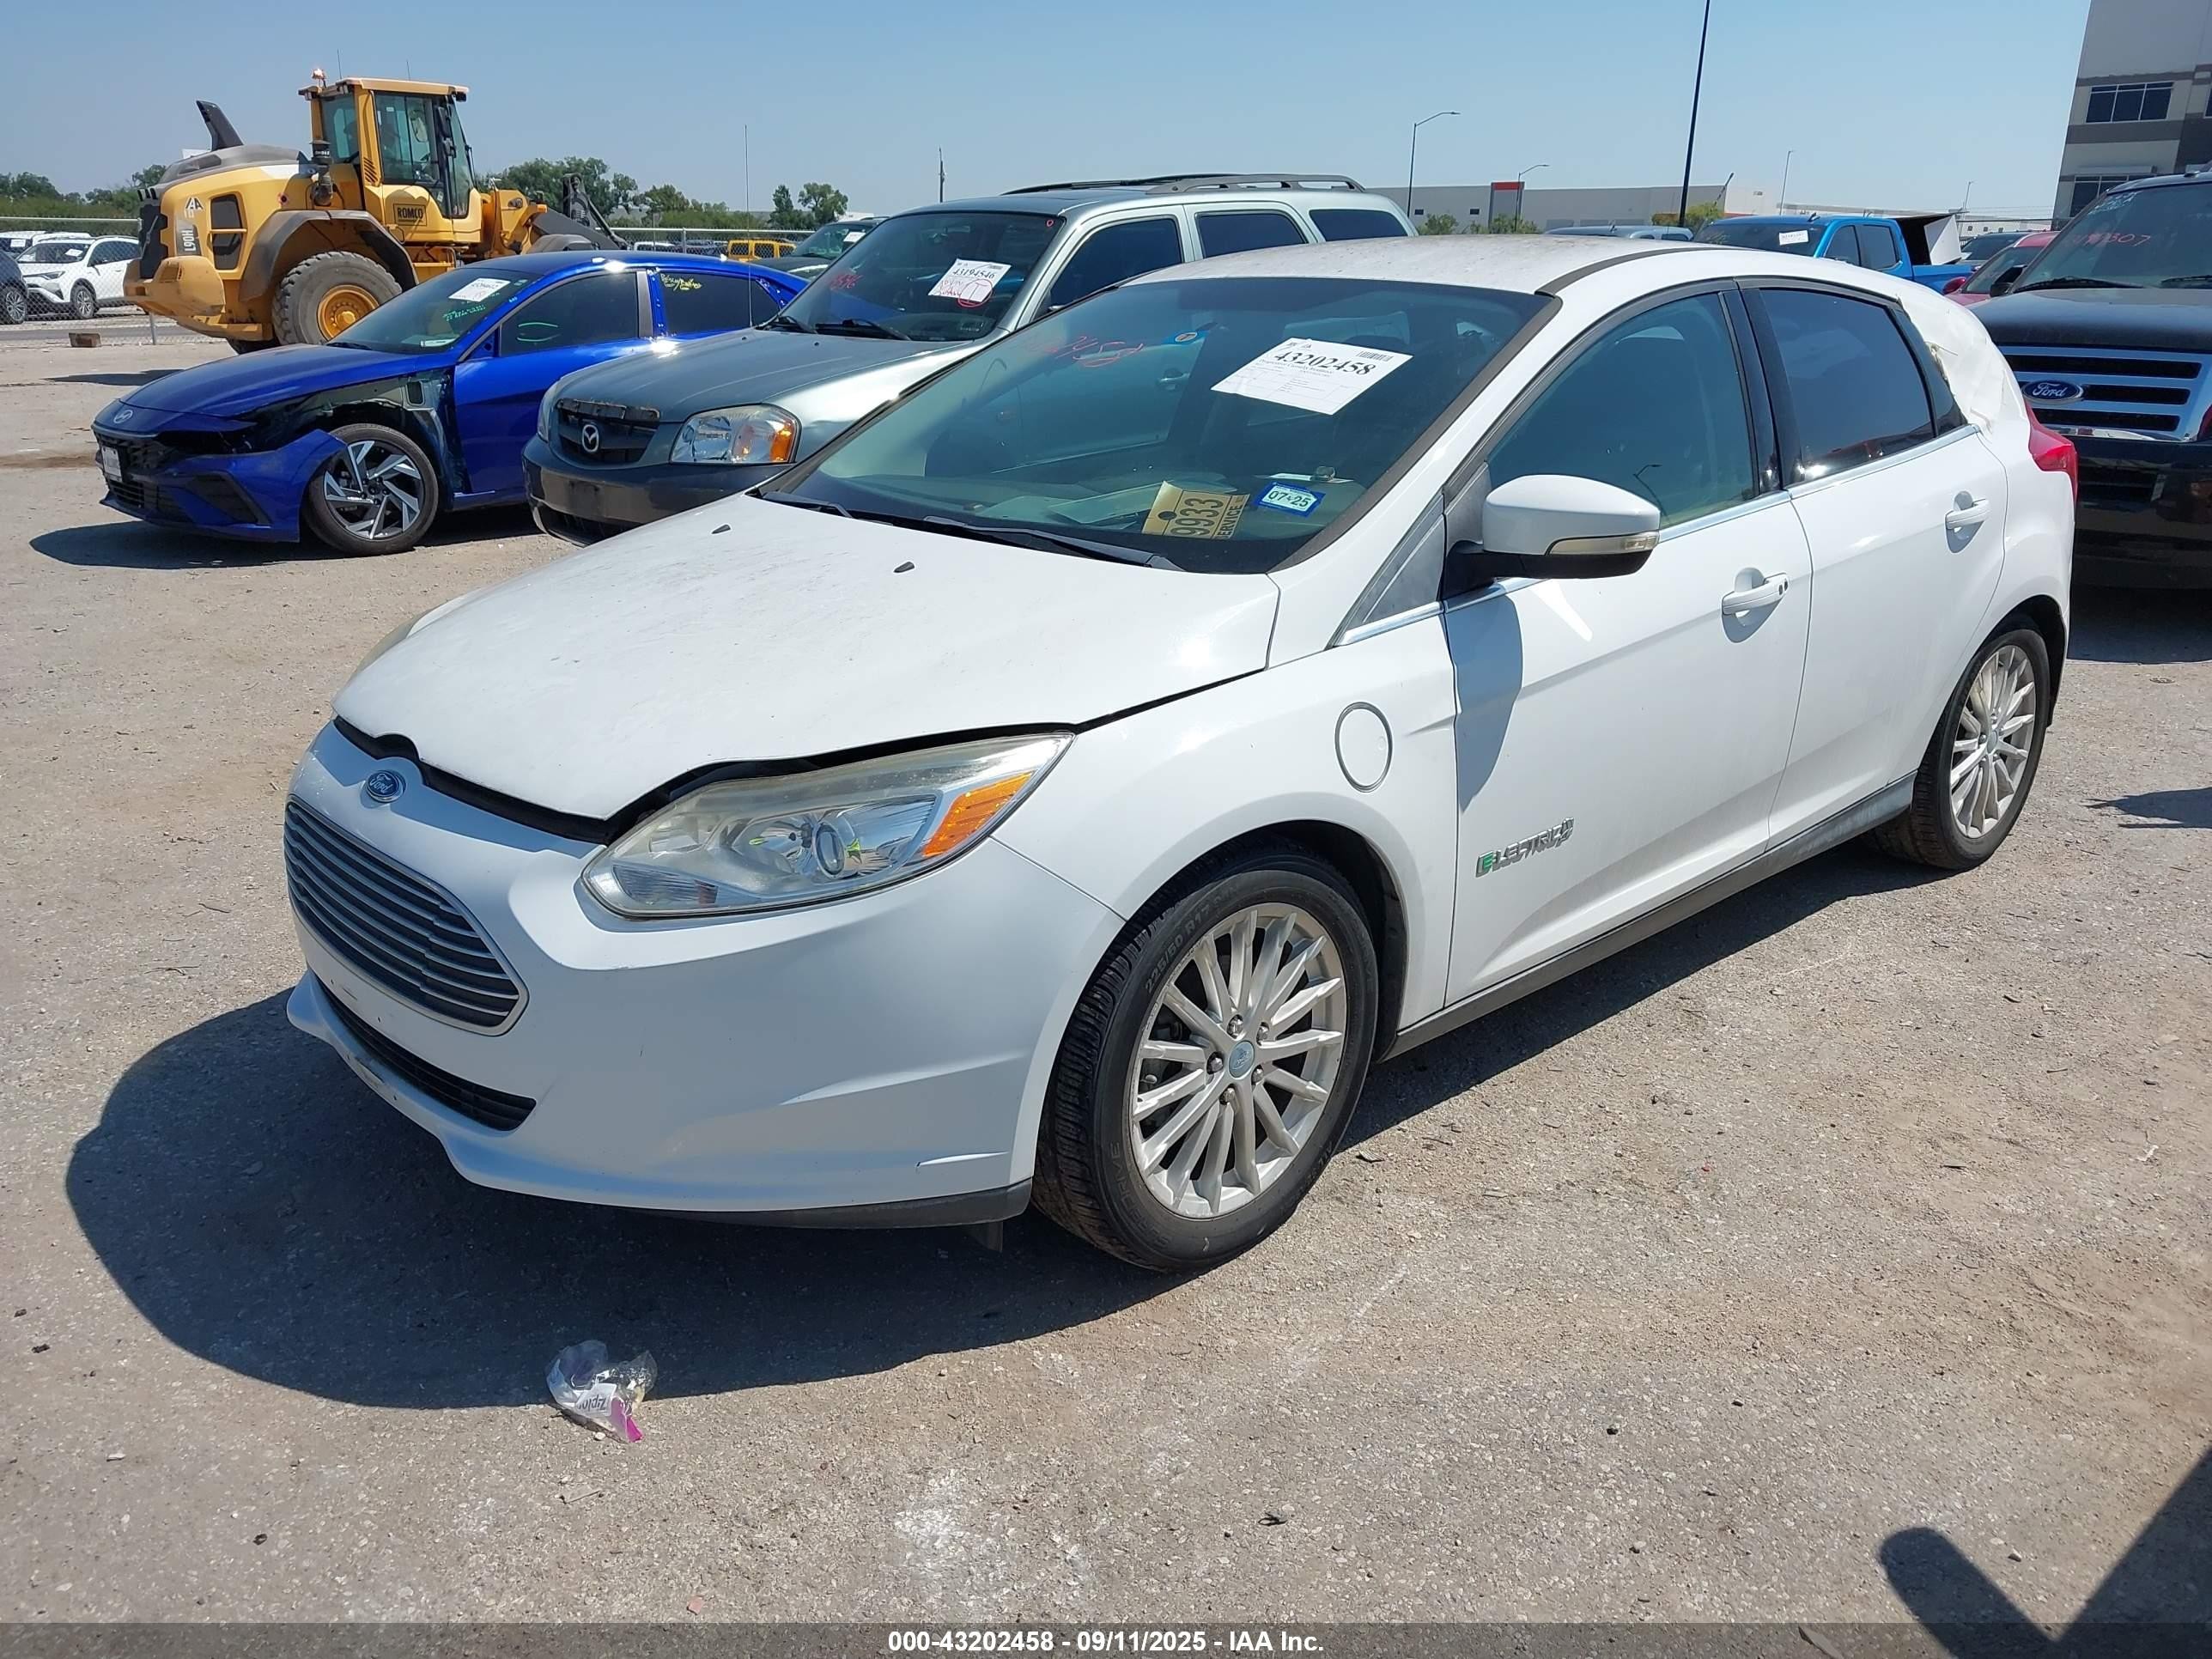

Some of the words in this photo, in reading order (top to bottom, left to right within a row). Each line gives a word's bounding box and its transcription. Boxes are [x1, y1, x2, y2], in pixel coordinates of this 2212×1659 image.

[397, 207, 423, 219] ROMCO
[181, 228, 197, 252] L90H
[1274, 351, 1376, 376] 43202458
[2032, 382, 2069, 397] Ford
[1268, 490, 1288, 501] 07
[1290, 495, 1311, 507] 25
[1170, 497, 1224, 536] 9933
[369, 773, 394, 794] Ford
[1475, 817, 1575, 878] ELECTRIC
[1145, 933, 1184, 994] 225/50
